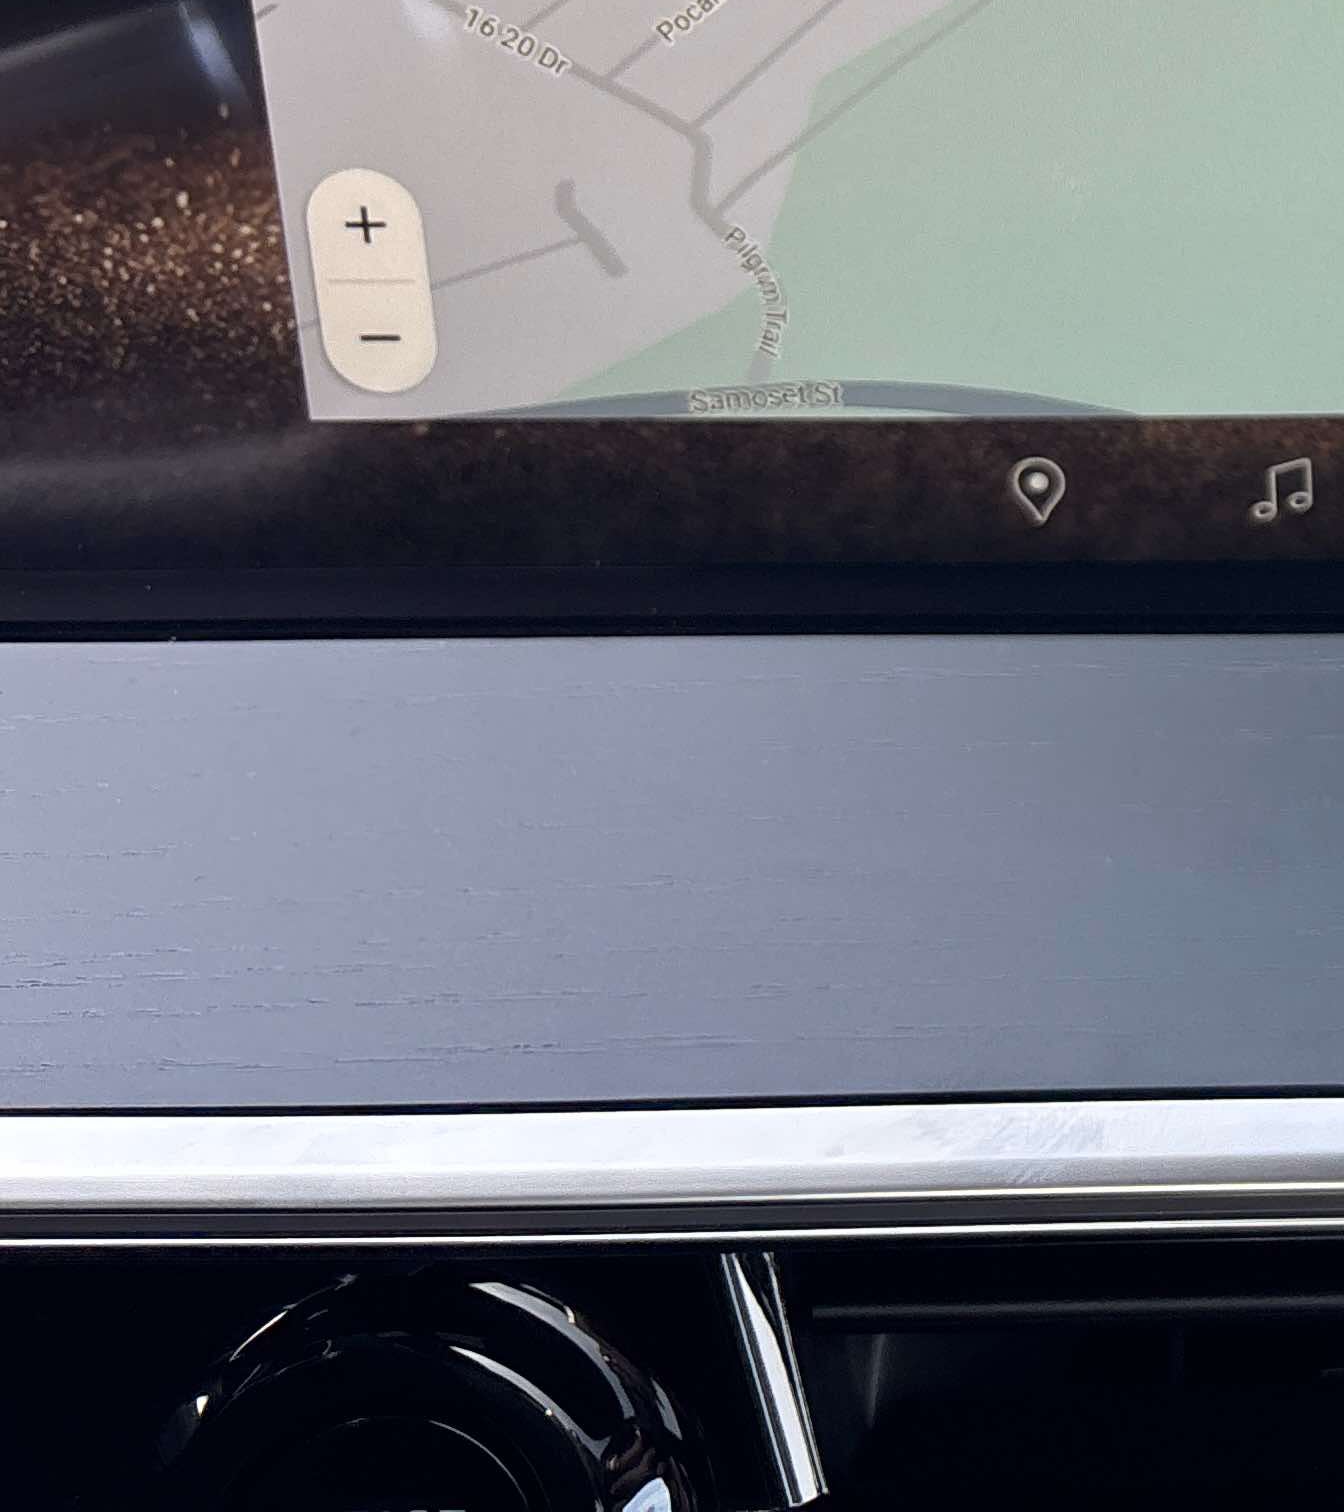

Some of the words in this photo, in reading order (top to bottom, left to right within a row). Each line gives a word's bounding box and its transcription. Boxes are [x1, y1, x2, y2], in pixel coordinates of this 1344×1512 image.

[537, 46, 570, 74] Dr
[725, 225, 780, 306] Pilgrim
[758, 308, 789, 359] Trail
[690, 384, 806, 414] Samoset
[814, 380, 843, 406] St
